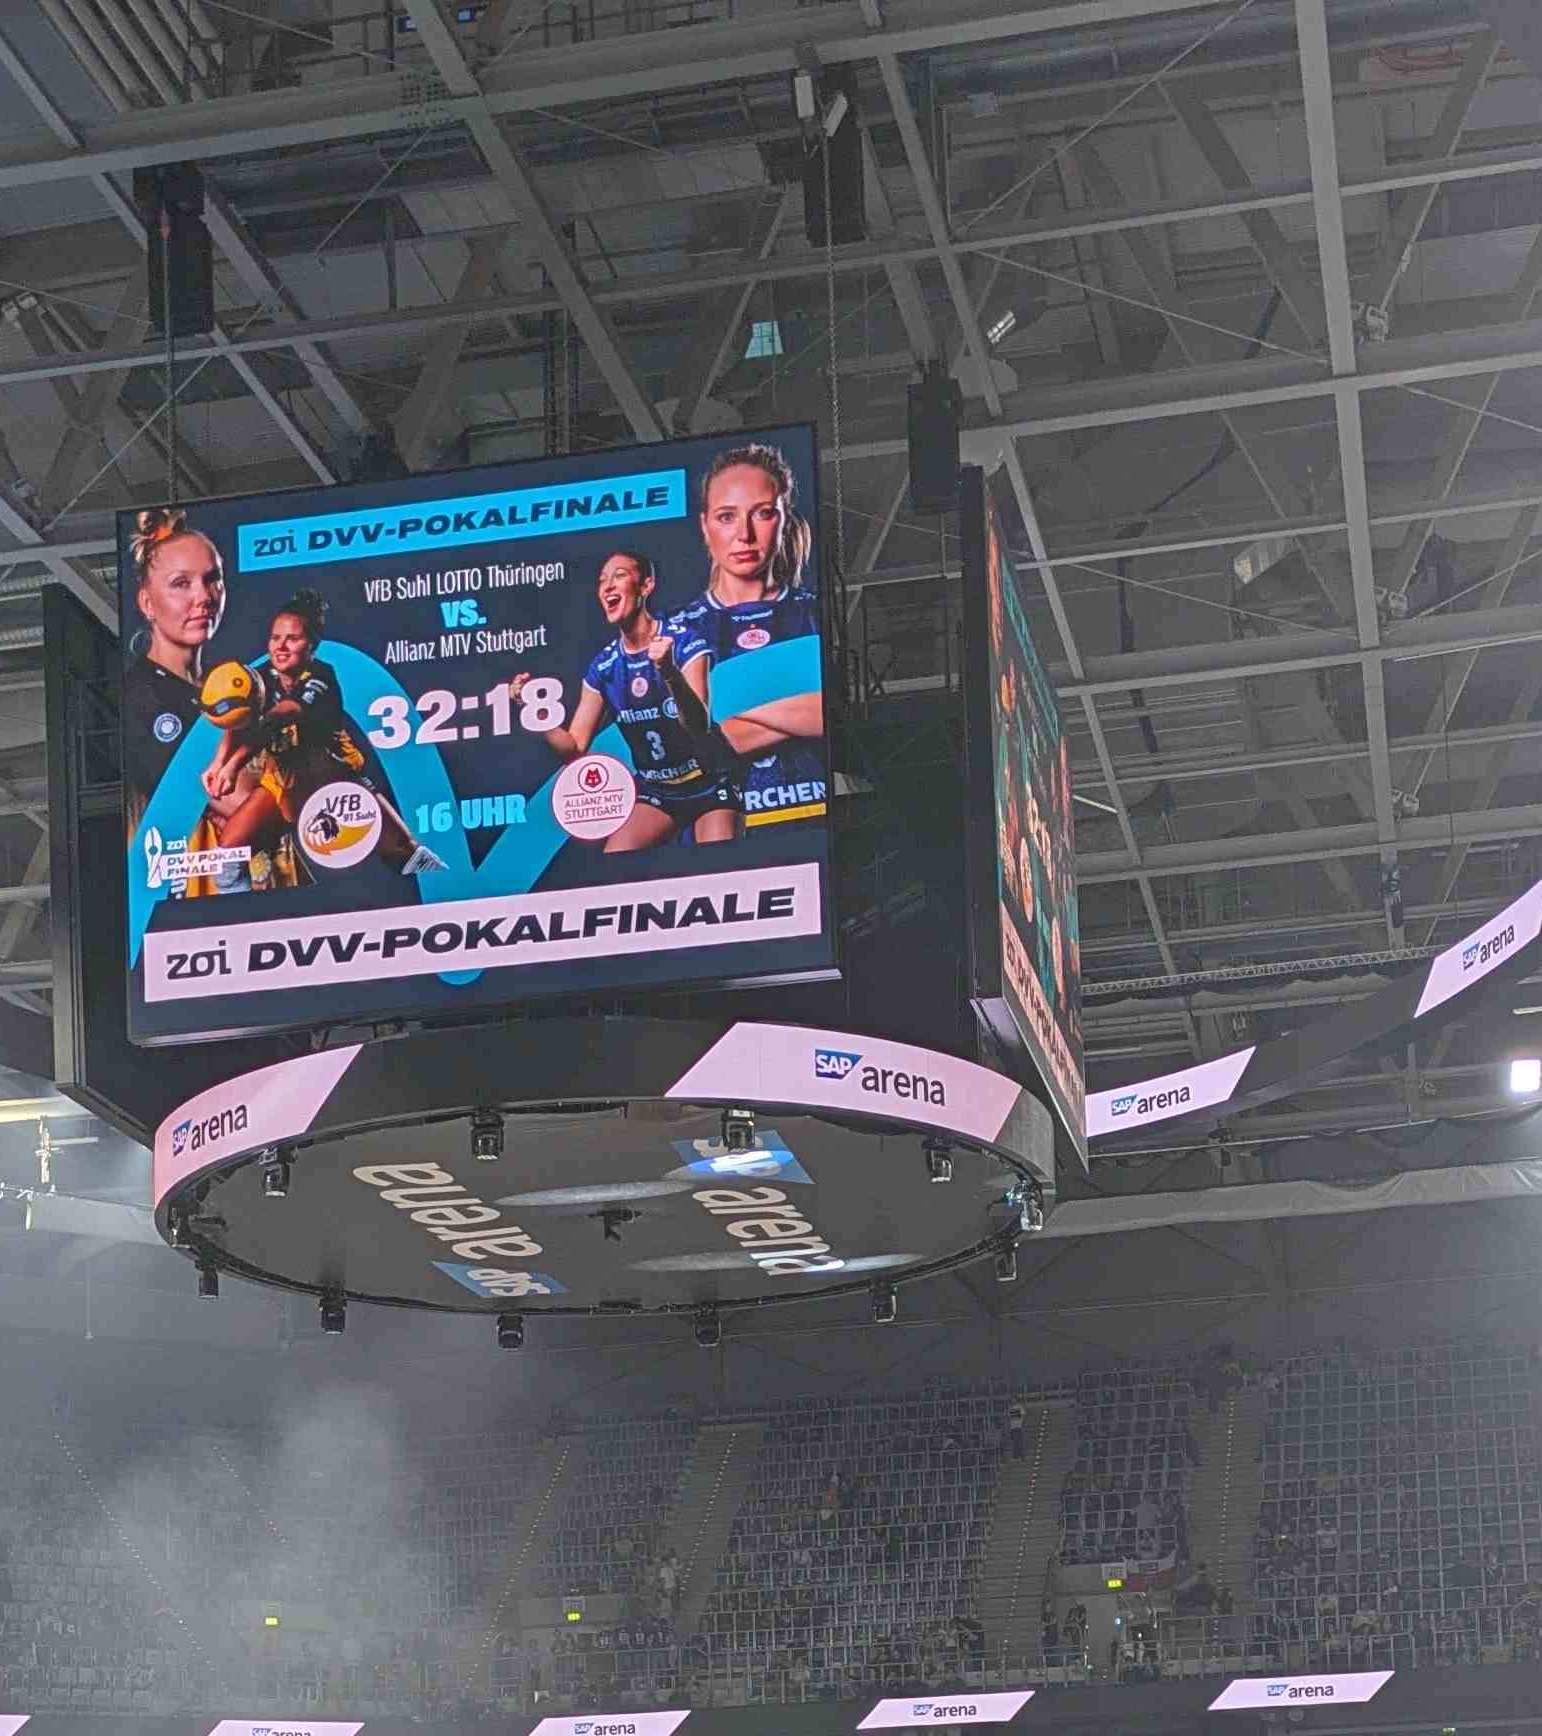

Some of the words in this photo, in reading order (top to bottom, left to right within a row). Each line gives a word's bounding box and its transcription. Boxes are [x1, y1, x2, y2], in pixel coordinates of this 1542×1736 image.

[253, 528, 298, 558] zoi
[307, 485, 670, 551] DVV-POKALFINALE
[364, 581, 393, 604] VfB
[396, 575, 431, 599] Suhl
[436, 568, 483, 595] LOTTO
[486, 561, 565, 590] Thüringen
[440, 599, 487, 629] VS.
[384, 638, 436, 665] Allianz
[439, 635, 471, 659] MTV
[475, 625, 548, 656] Stuttgart
[367, 675, 568, 751] 32:18
[645, 730, 666, 761] 3
[324, 793, 362, 816] VfB
[415, 802, 452, 834] 16
[461, 793, 527, 828] UHR
[564, 795, 603, 808] ALLIANZ
[604, 793, 623, 805] MTV
[564, 804, 624, 820] STUTTGART
[166, 863, 219, 877] FINALE
[197, 850, 247, 864] POKAL
[166, 939, 233, 981] zoi
[246, 886, 797, 973] DVV-POKALFINALE
[1479, 924, 1516, 964] arena
[816, 1049, 855, 1079] SAP
[862, 1060, 948, 1107] arena
[1111, 1098, 1134, 1114] SAP
[1136, 1083, 1191, 1115] arena
[190, 1103, 249, 1152] arena
[352, 1161, 544, 1261] arena
[1287, 1681, 1335, 1700] arena
[933, 1701, 977, 1719] arena
